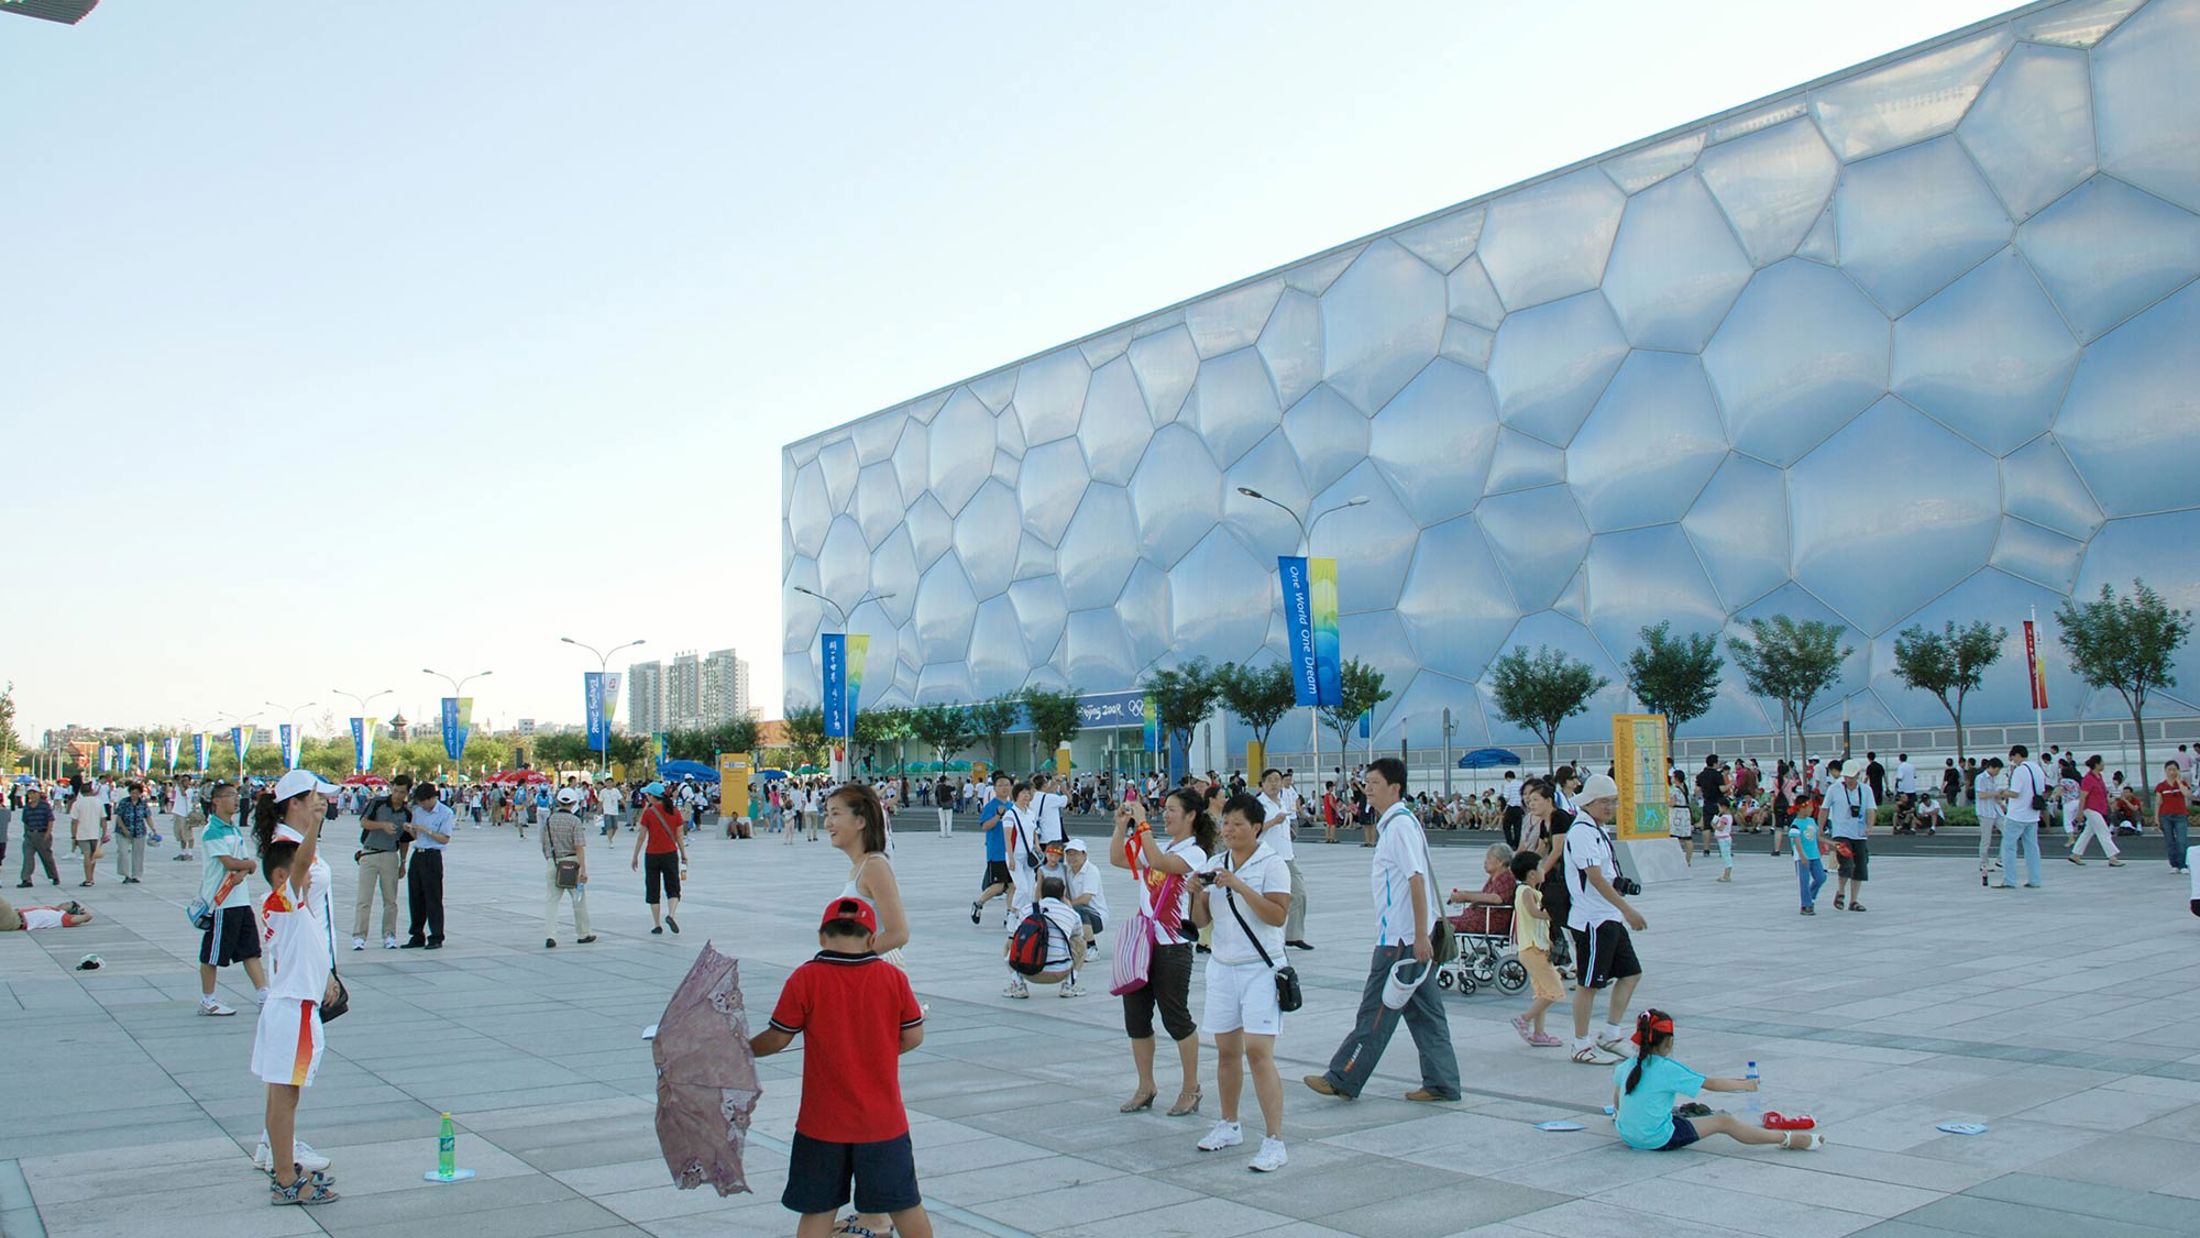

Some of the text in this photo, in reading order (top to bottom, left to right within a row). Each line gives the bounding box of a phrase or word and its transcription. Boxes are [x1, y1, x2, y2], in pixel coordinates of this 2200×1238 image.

[1289, 565, 1317, 695] One World One Dream
